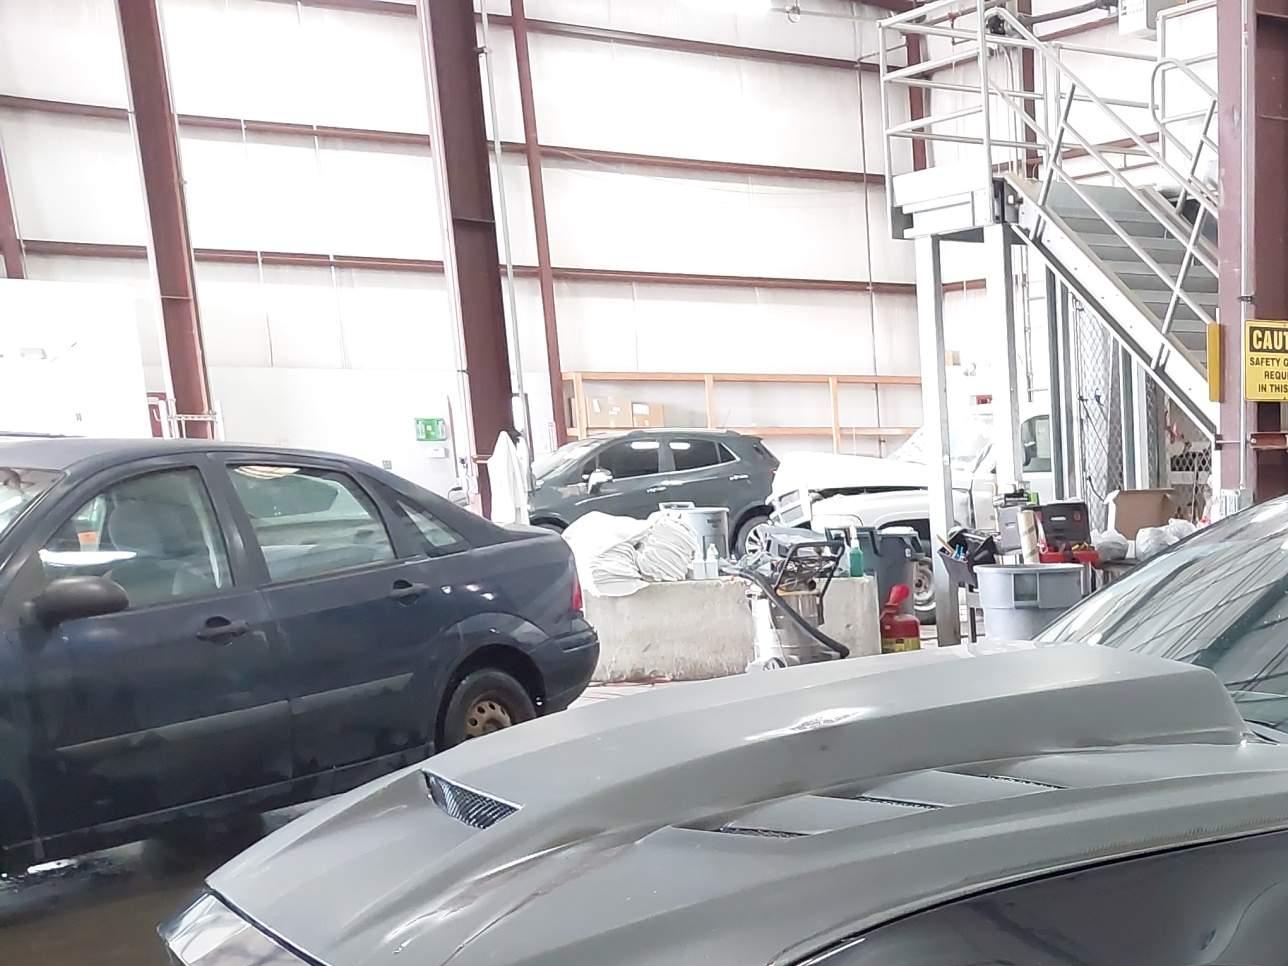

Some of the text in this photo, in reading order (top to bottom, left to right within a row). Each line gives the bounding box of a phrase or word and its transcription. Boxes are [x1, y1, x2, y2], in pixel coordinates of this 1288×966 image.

[1249, 356, 1281, 367] SAFETY
[1258, 383, 1267, 393] IN
[1269, 384, 1288, 394] THIS
